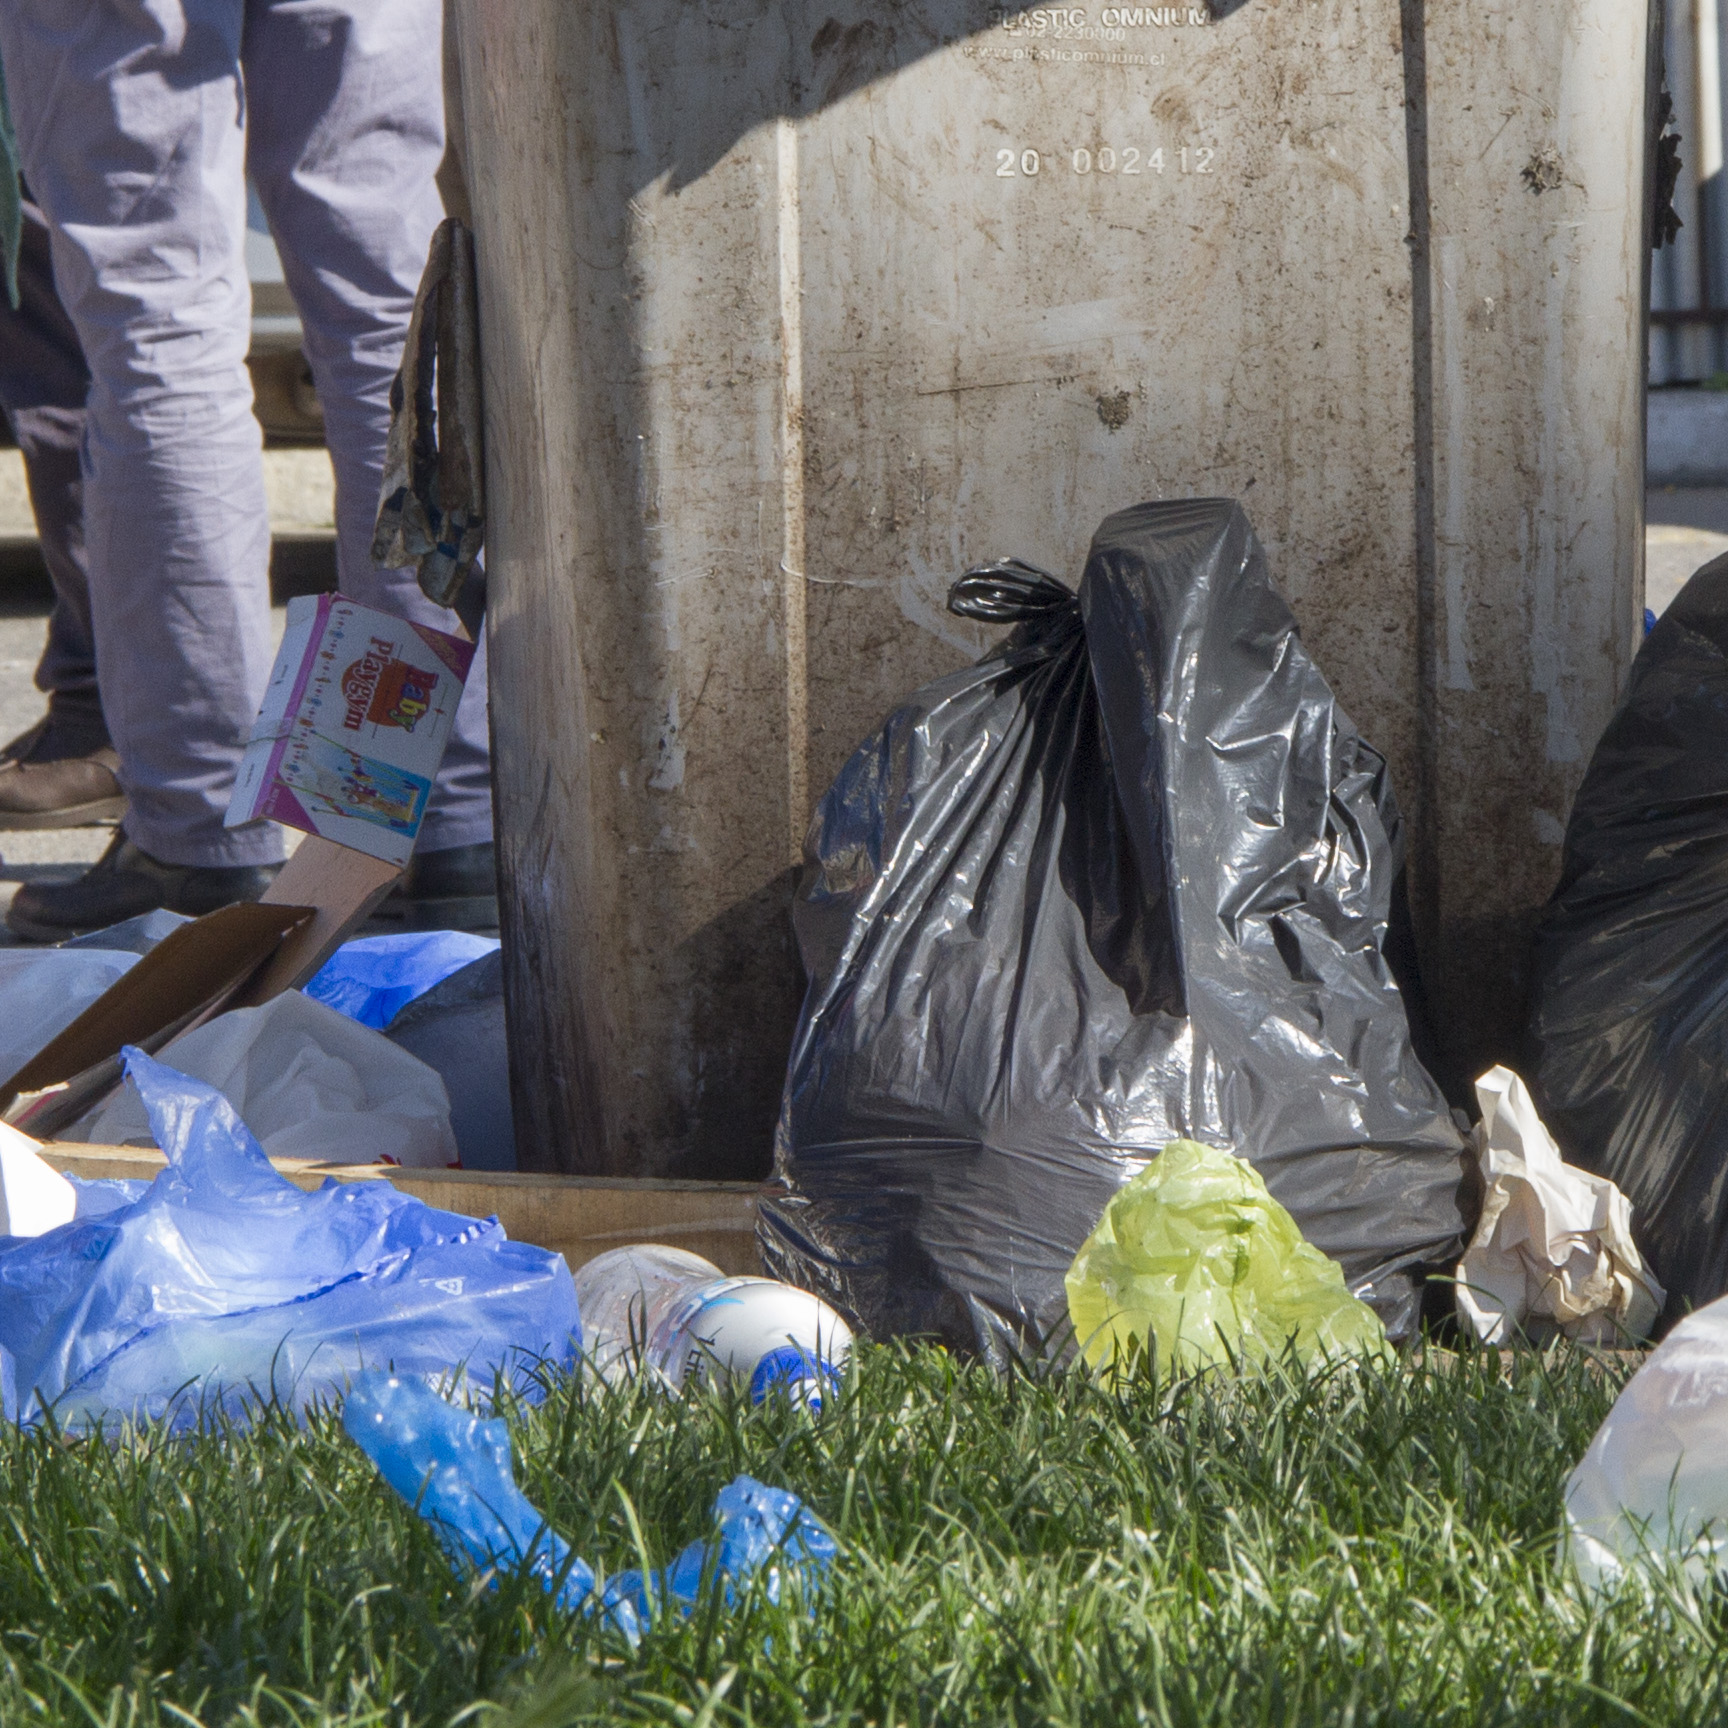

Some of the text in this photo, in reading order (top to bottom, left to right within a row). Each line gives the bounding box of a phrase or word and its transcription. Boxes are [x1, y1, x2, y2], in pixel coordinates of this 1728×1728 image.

[1101, 7, 1210, 28] OMNIUM
[995, 145, 1215, 178] 20 002412
[344, 635, 394, 731] Playgym
[389, 666, 439, 733] Baby
